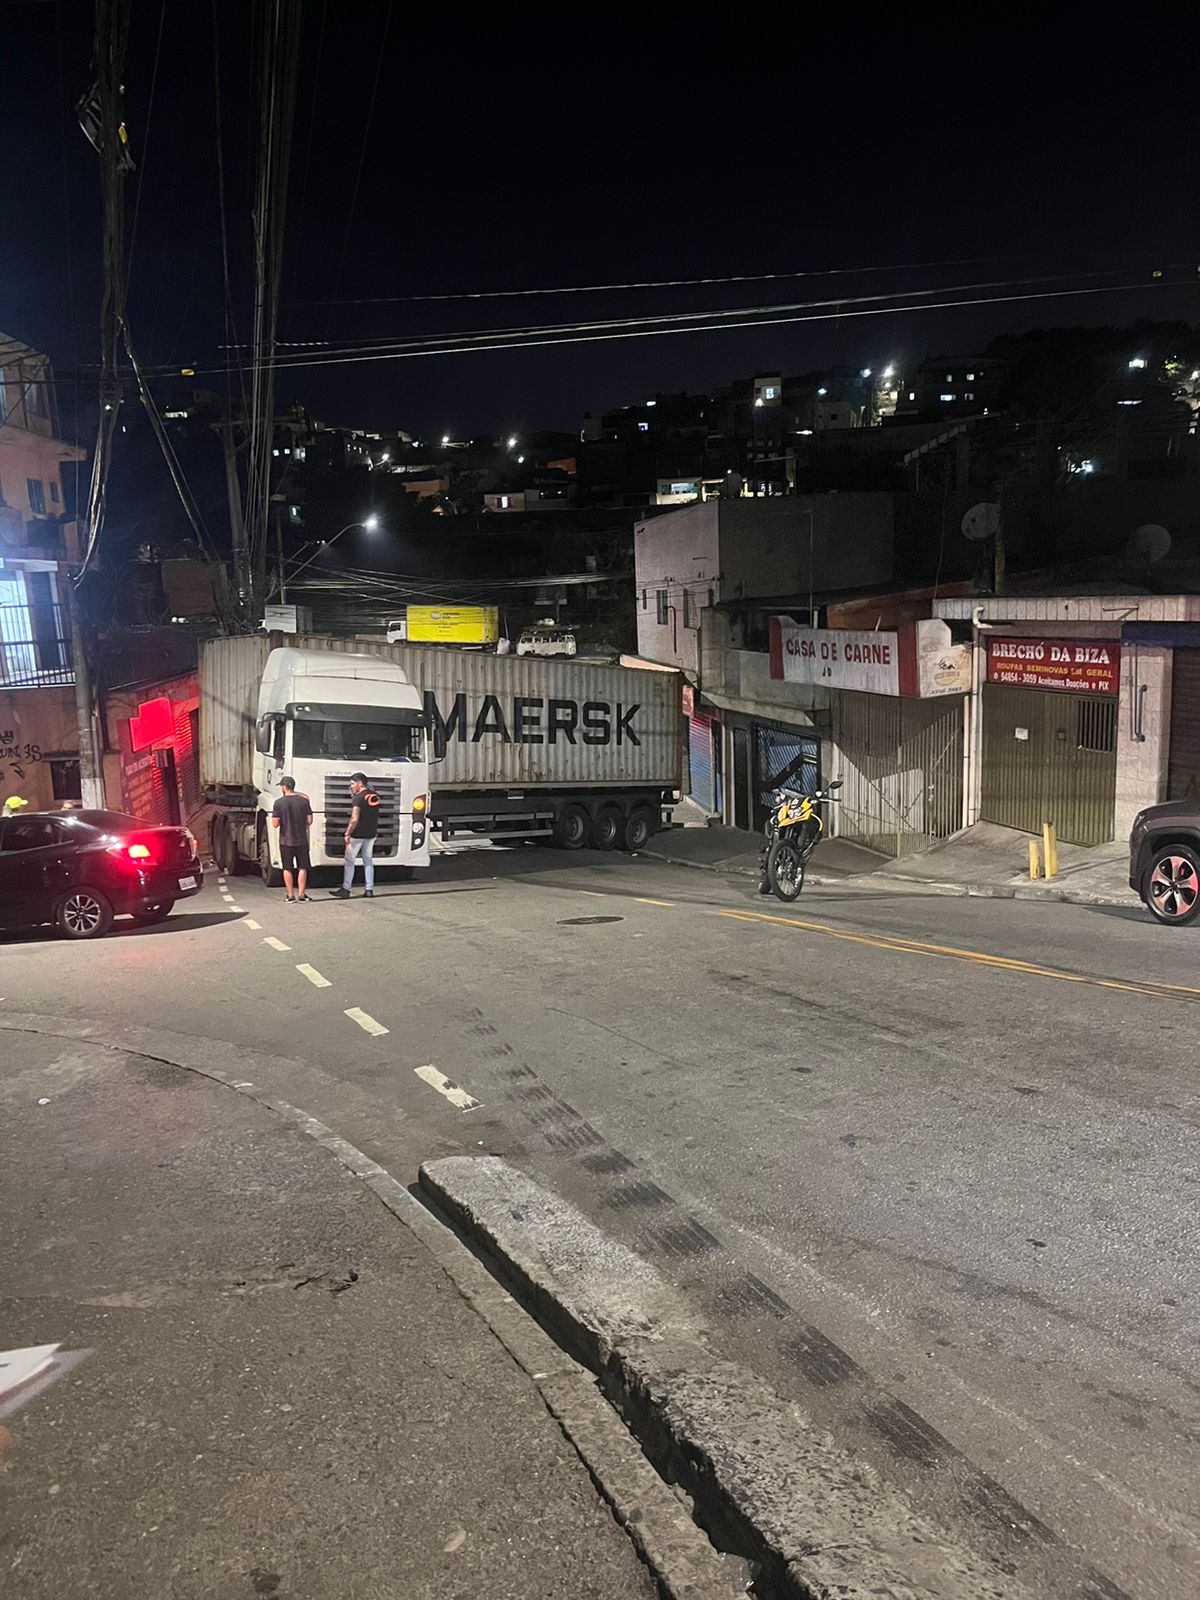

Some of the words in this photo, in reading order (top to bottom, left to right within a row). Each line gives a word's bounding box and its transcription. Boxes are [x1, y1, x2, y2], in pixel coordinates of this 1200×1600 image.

[786, 639, 816, 658] CASA
[821, 641, 838, 661] DE
[844, 643, 891, 665] CARNE
[992, 641, 1045, 660] BRECHÓ
[1050, 647, 1071, 662] DA
[1074, 648, 1110, 664] BIZA
[996, 662, 1023, 671] ROUPAS
[1026, 664, 1069, 675] SEMINOVAS
[1086, 668, 1113, 678] GERAL
[1065, 678, 1090, 690] Doações
[1098, 681, 1109, 691] PIX
[423, 690, 642, 746] MAERSK
